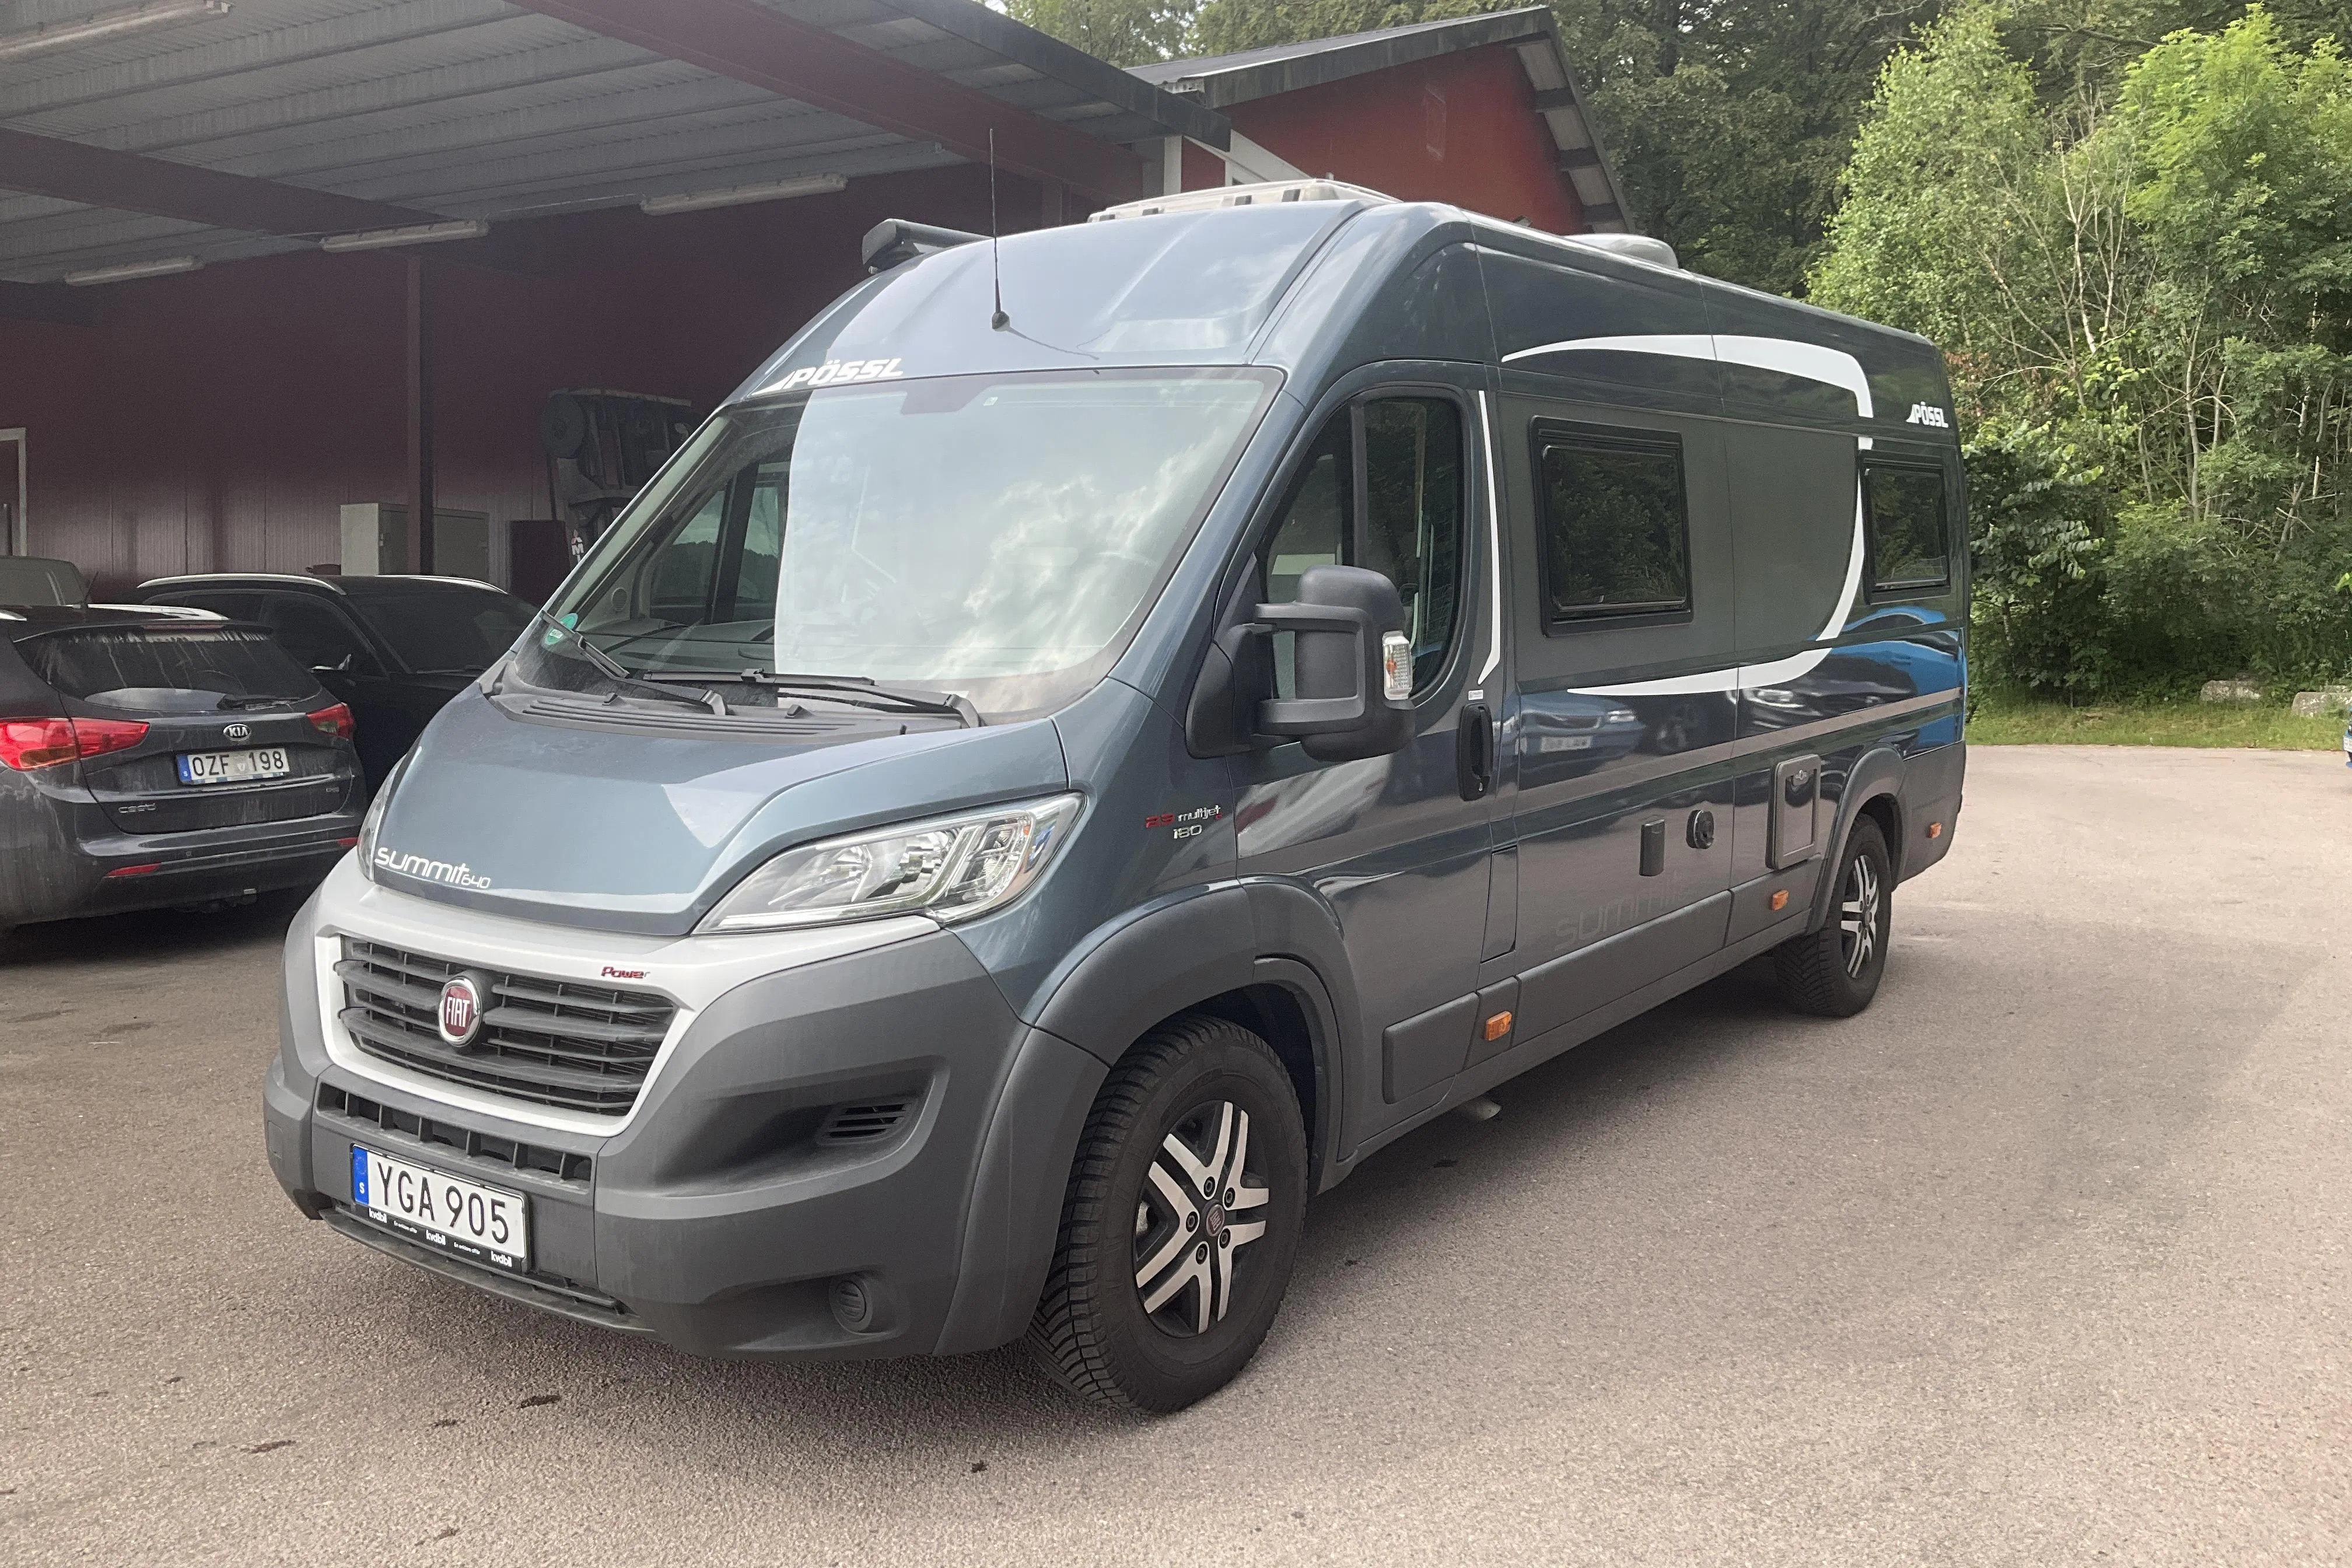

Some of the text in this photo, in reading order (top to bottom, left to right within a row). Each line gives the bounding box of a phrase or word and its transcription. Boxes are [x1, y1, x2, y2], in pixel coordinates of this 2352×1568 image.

[783, 358, 904, 389] PÖSSL
[1912, 401, 1948, 428] PÖSSL
[229, 726, 249, 737] KIA
[192, 754, 230, 776] OZF
[249, 751, 284, 772] 198
[446, 996, 470, 1027] FIAT
[359, 1161, 509, 1244] S YGA 905
